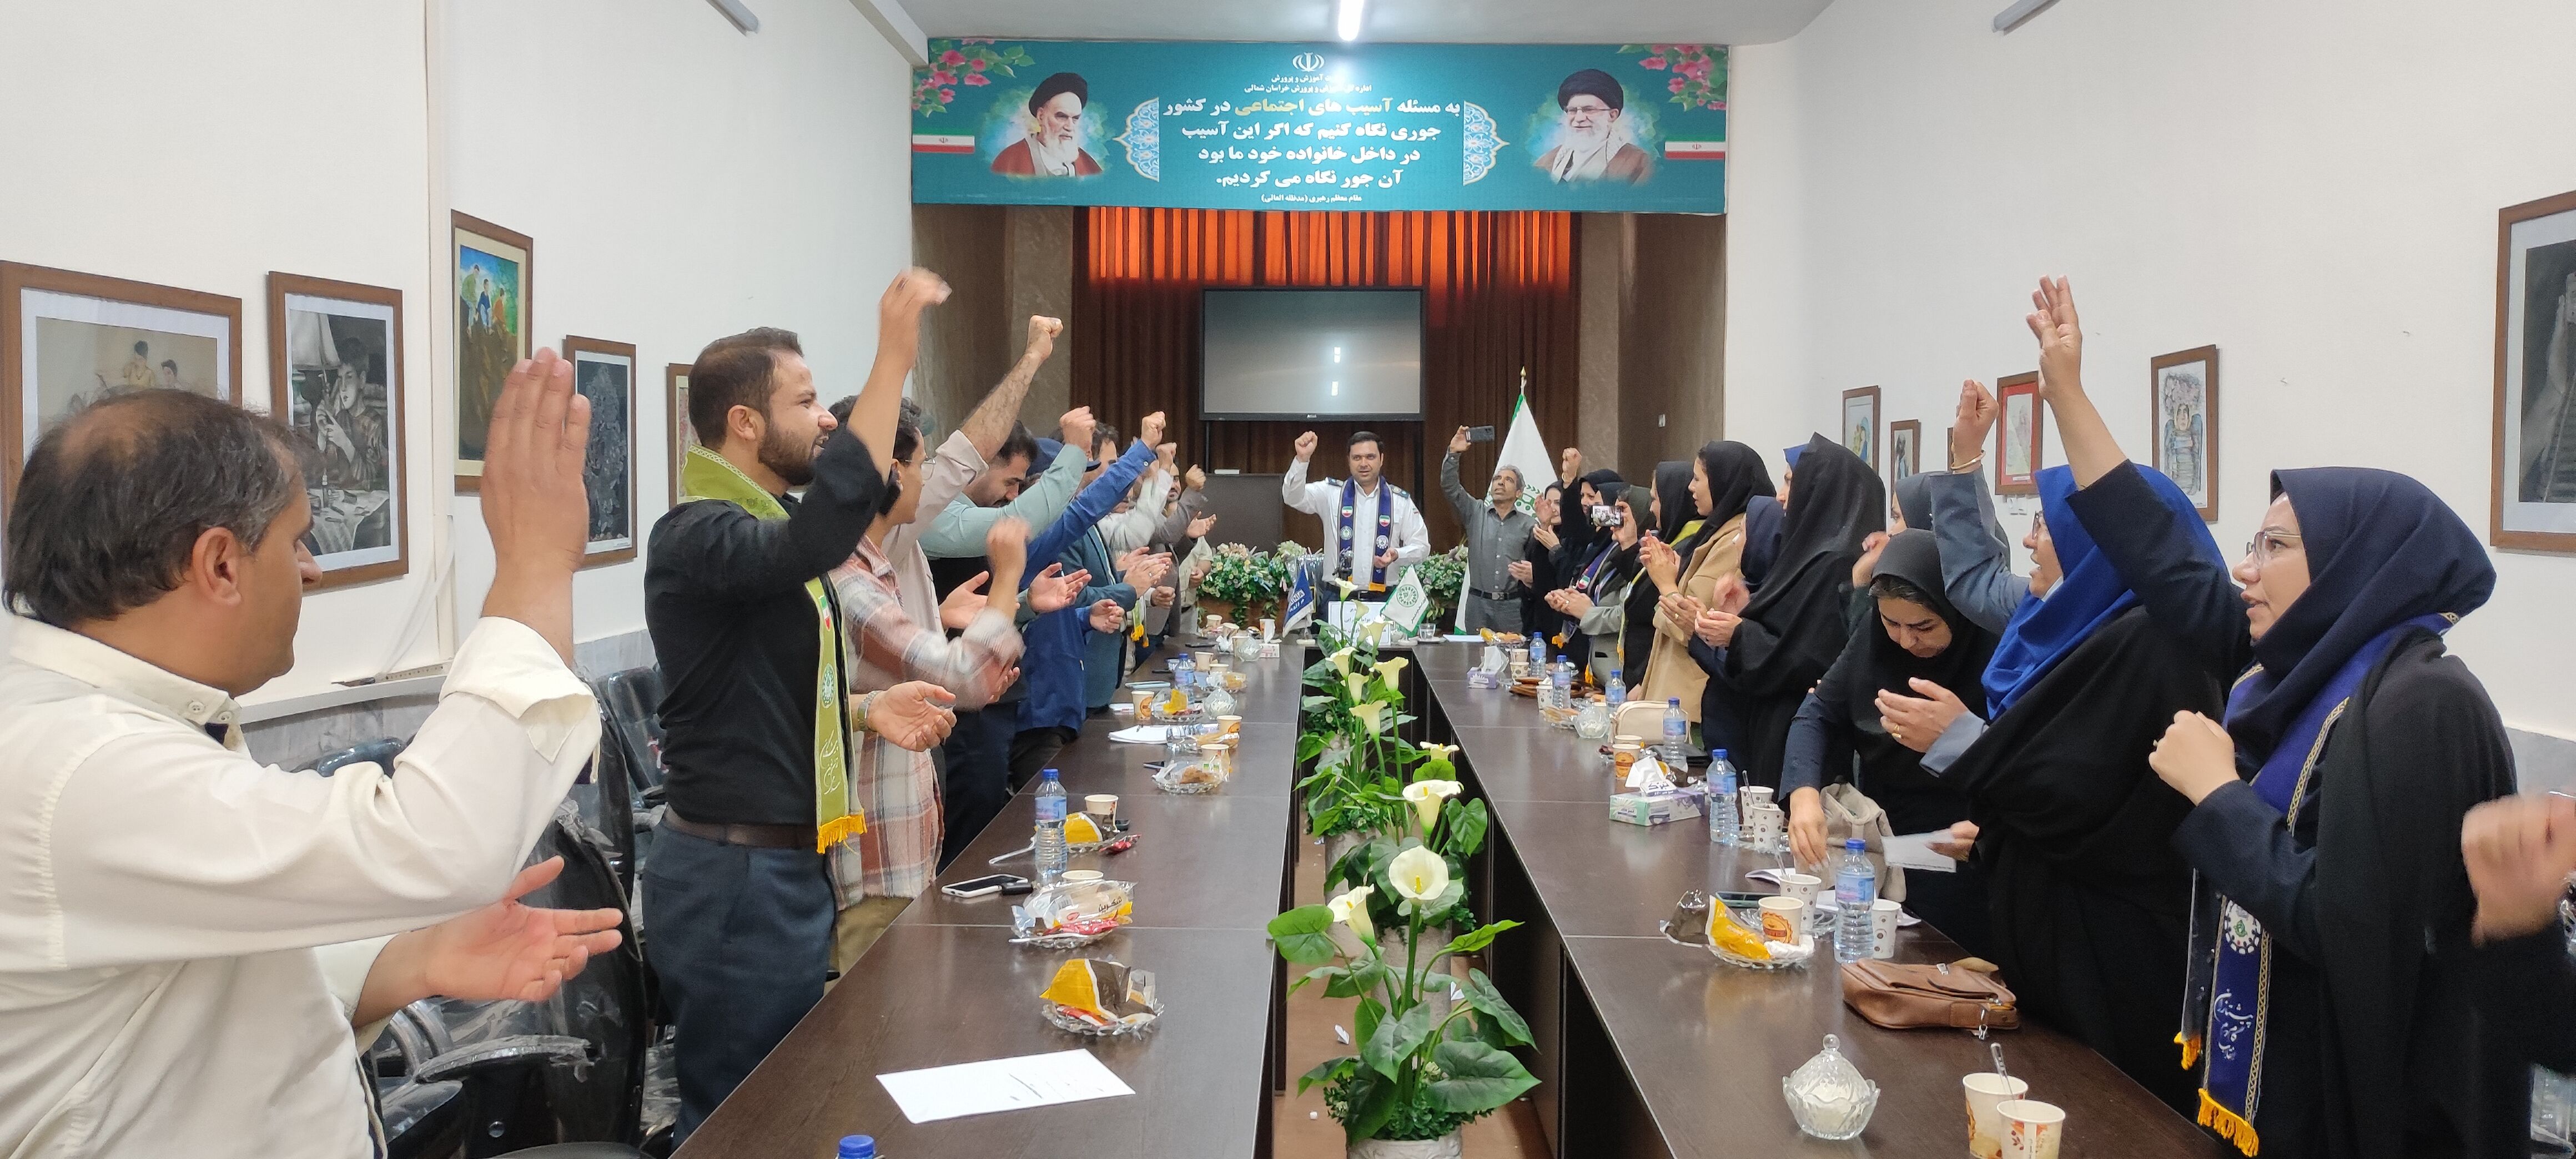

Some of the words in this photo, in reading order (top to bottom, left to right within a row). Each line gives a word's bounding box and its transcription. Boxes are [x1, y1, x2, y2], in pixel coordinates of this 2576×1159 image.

[1271, 74, 1294, 84] پرورش
[1300, 73, 1324, 83] آموزش
[1244, 84, 1265, 93] شمالی
[1265, 84, 1290, 93] خراسان
[1163, 98, 1206, 116] کشور
[1209, 100, 1231, 116] در
[1235, 98, 1304, 116] اجتماعی
[1308, 98, 1342, 116] های
[1346, 97, 1393, 116] آسیب
[1396, 99, 1441, 114] مسئله
[1445, 102, 1461, 117] به
[1181, 120, 1230, 139] آسیب
[1232, 121, 1261, 140] این
[1293, 121, 1315, 136] که
[1317, 122, 1352, 140] کنیم
[1390, 127, 1442, 141] جوری
[1198, 148, 1225, 164] بود
[1228, 145, 1244, 160] ما
[1247, 145, 1282, 164] خود
[1286, 145, 1347, 165] خانواده
[1350, 145, 1396, 164] داخل
[1399, 149, 1421, 165] در
[1274, 174, 1301, 188] می
[1340, 173, 1374, 188] جور
[1377, 168, 1404, 189] آن
[1309, 195, 1330, 203] رهبری
